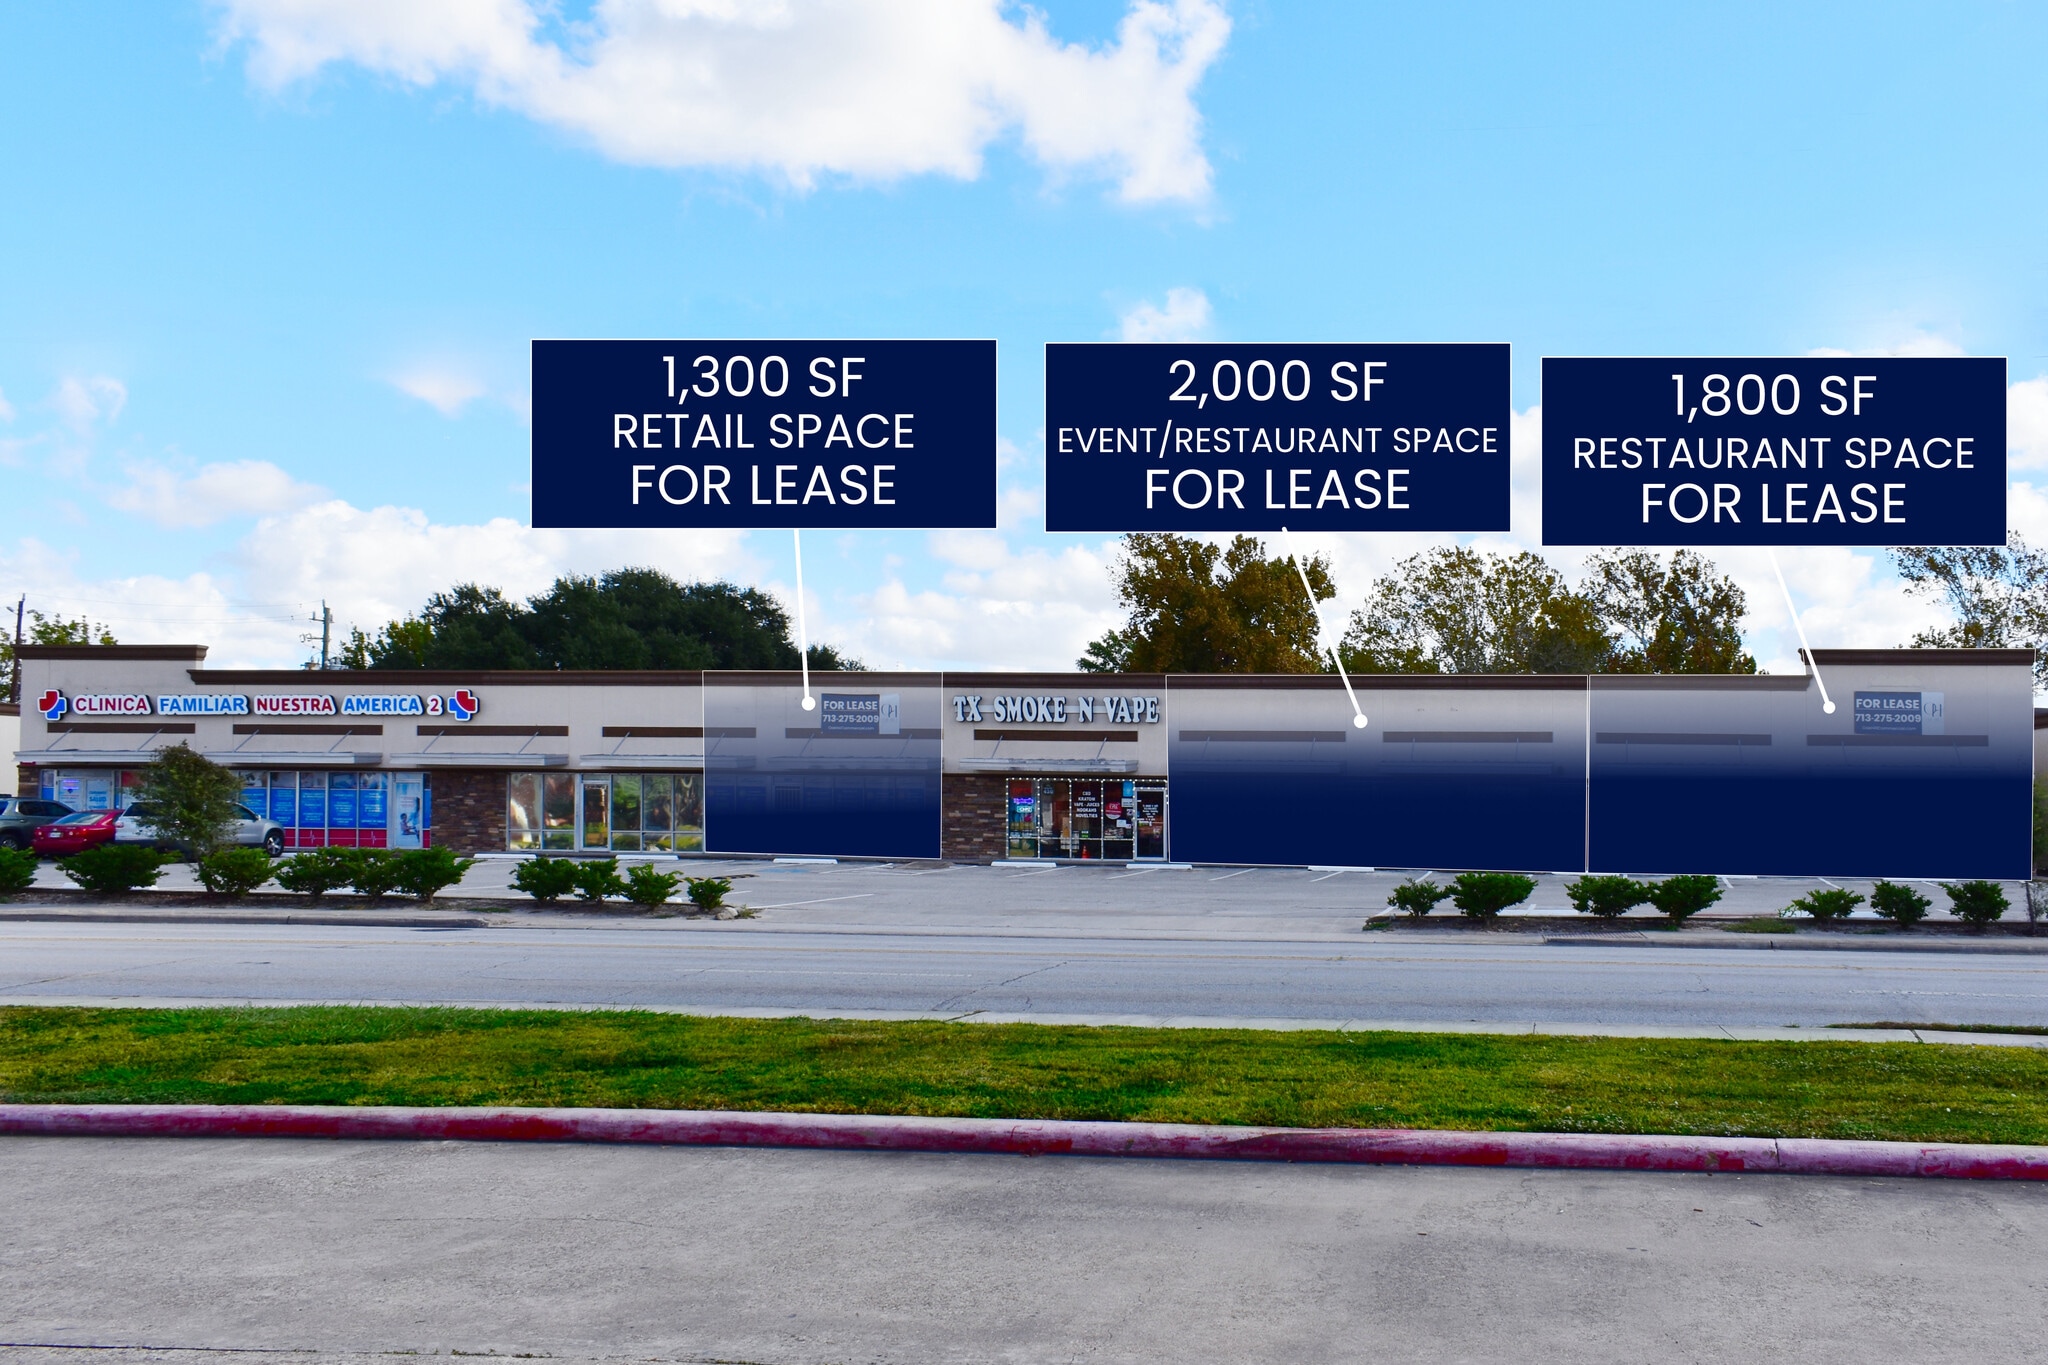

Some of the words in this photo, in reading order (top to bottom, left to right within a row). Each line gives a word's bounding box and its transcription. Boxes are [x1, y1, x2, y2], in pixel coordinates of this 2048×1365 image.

[75, 697, 149, 713] CLINICA
[159, 697, 246, 713] FAMILIAR
[256, 697, 333, 713] NUESTRA
[343, 697, 421, 713] AMERICA
[429, 697, 440, 713] 2
[823, 700, 845, 710] FOR
[847, 700, 878, 711] LEASE
[1856, 698, 1881, 709] FOR
[1883, 699, 1920, 709] LEASE
[953, 696, 983, 722] TX
[993, 696, 1067, 723] SMOKE
[1078, 696, 1095, 723] N
[1103, 696, 1160, 724] VAPE
[822, 714, 879, 723] 713-275-2009
[1854, 713, 1921, 723] 713-275-2009
